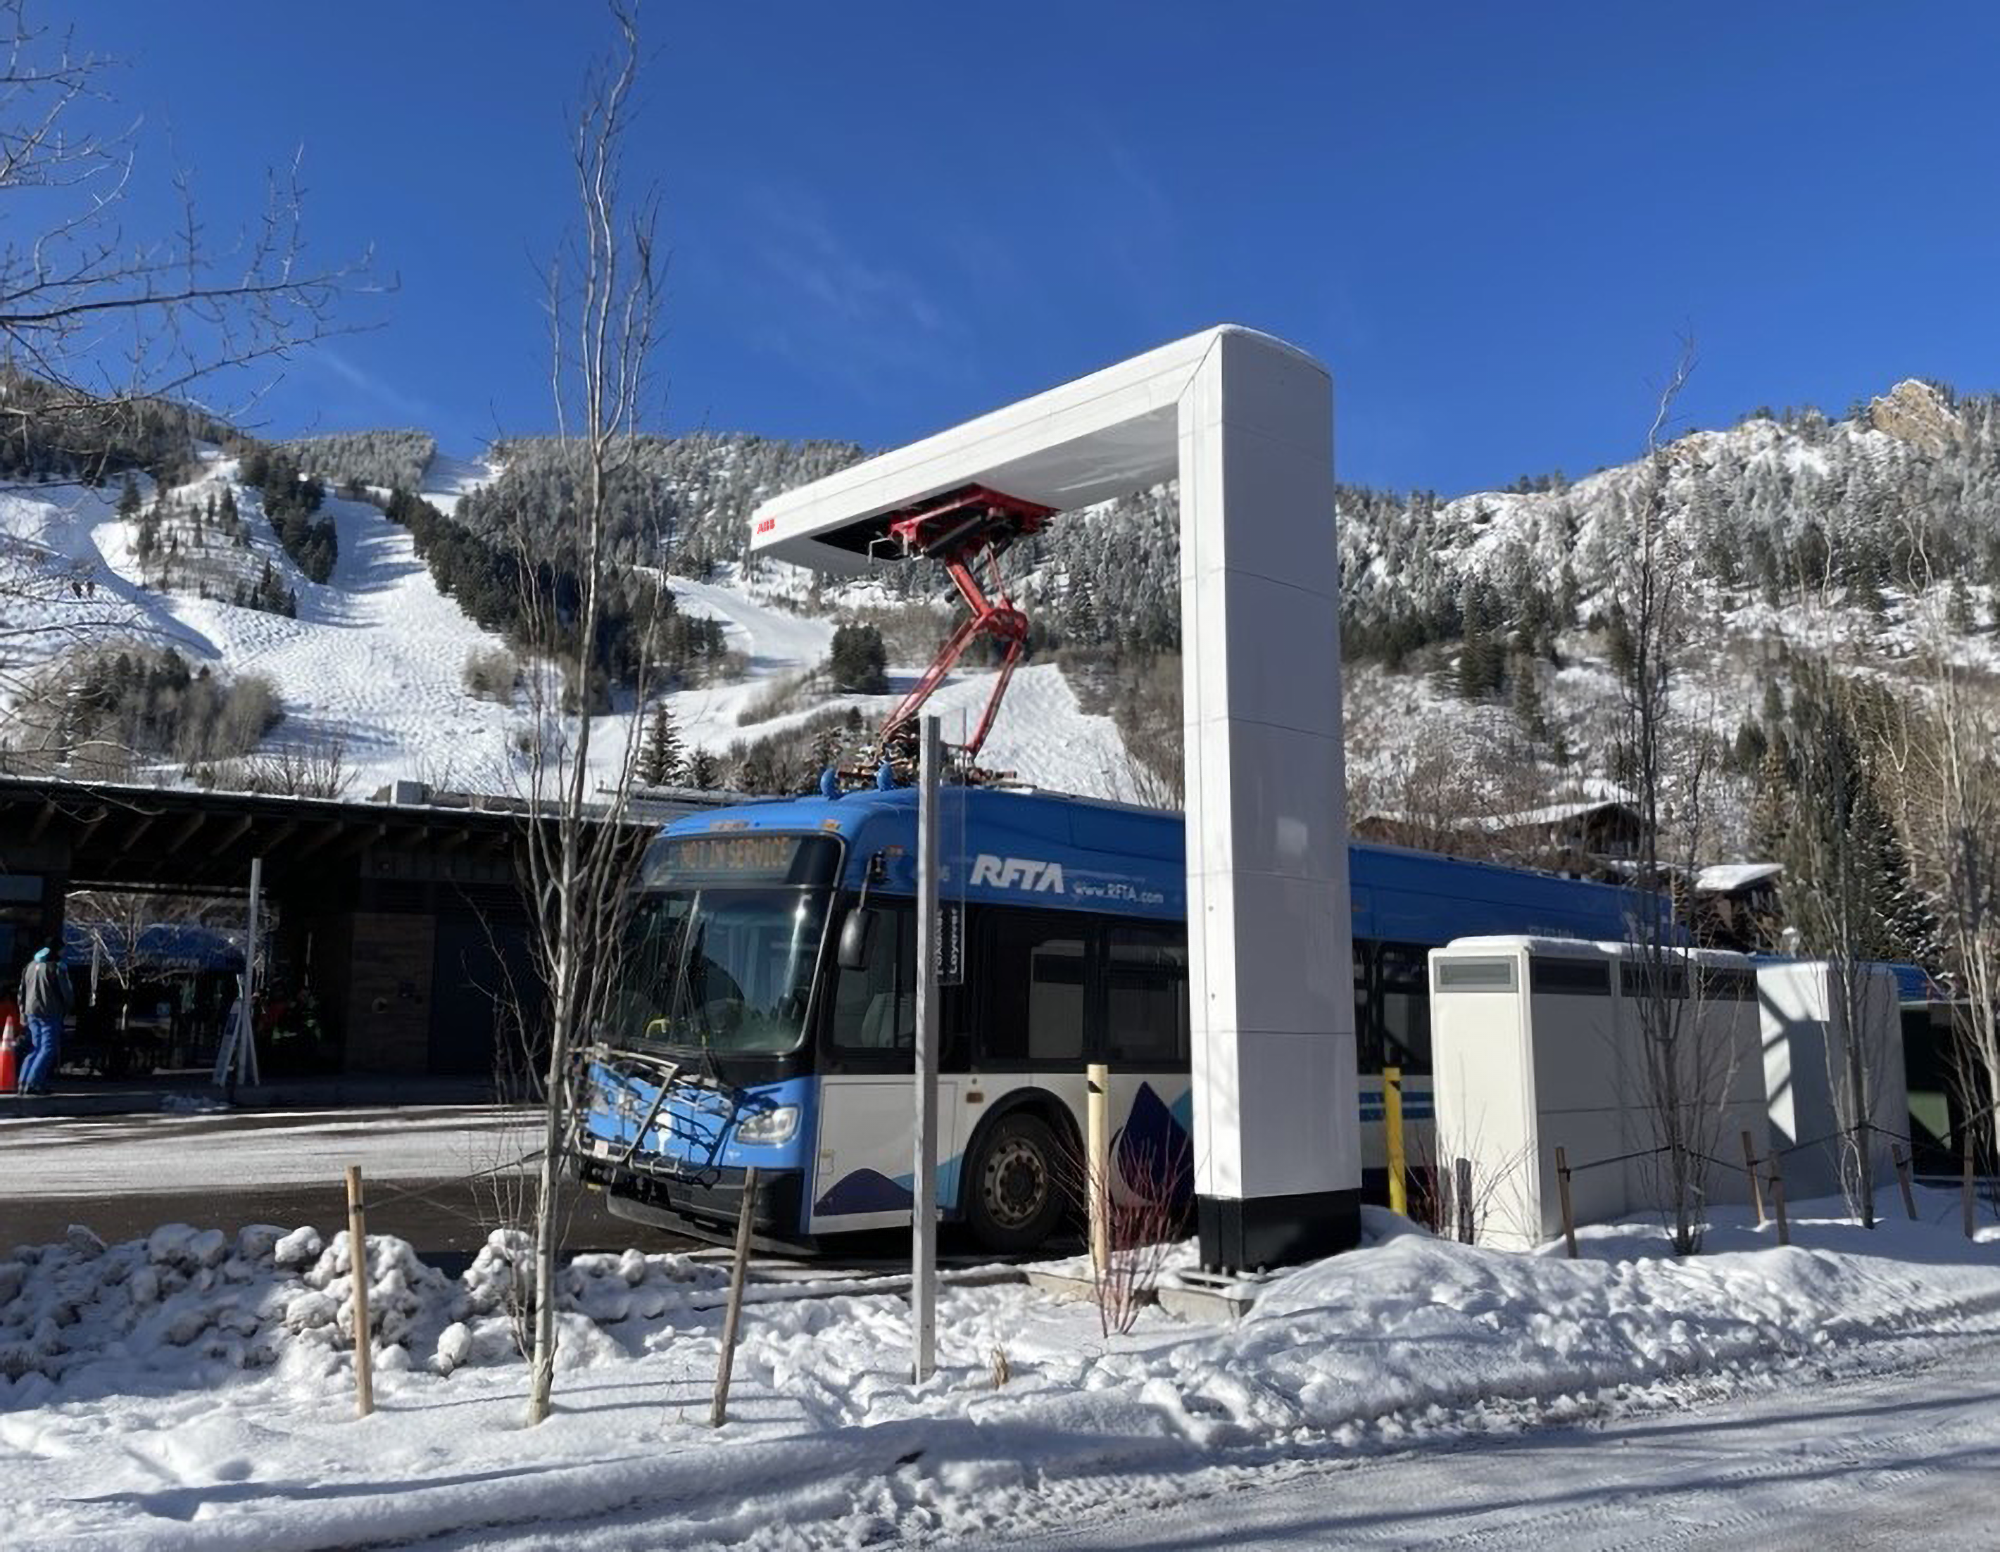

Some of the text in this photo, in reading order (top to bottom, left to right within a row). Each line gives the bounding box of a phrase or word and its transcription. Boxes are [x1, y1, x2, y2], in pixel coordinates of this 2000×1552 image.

[756, 518, 776, 535] ABB
[728, 837, 790, 868] SERVICE
[970, 854, 1065, 894] RFTA
[1073, 881, 1164, 904] www.RFTA.com
